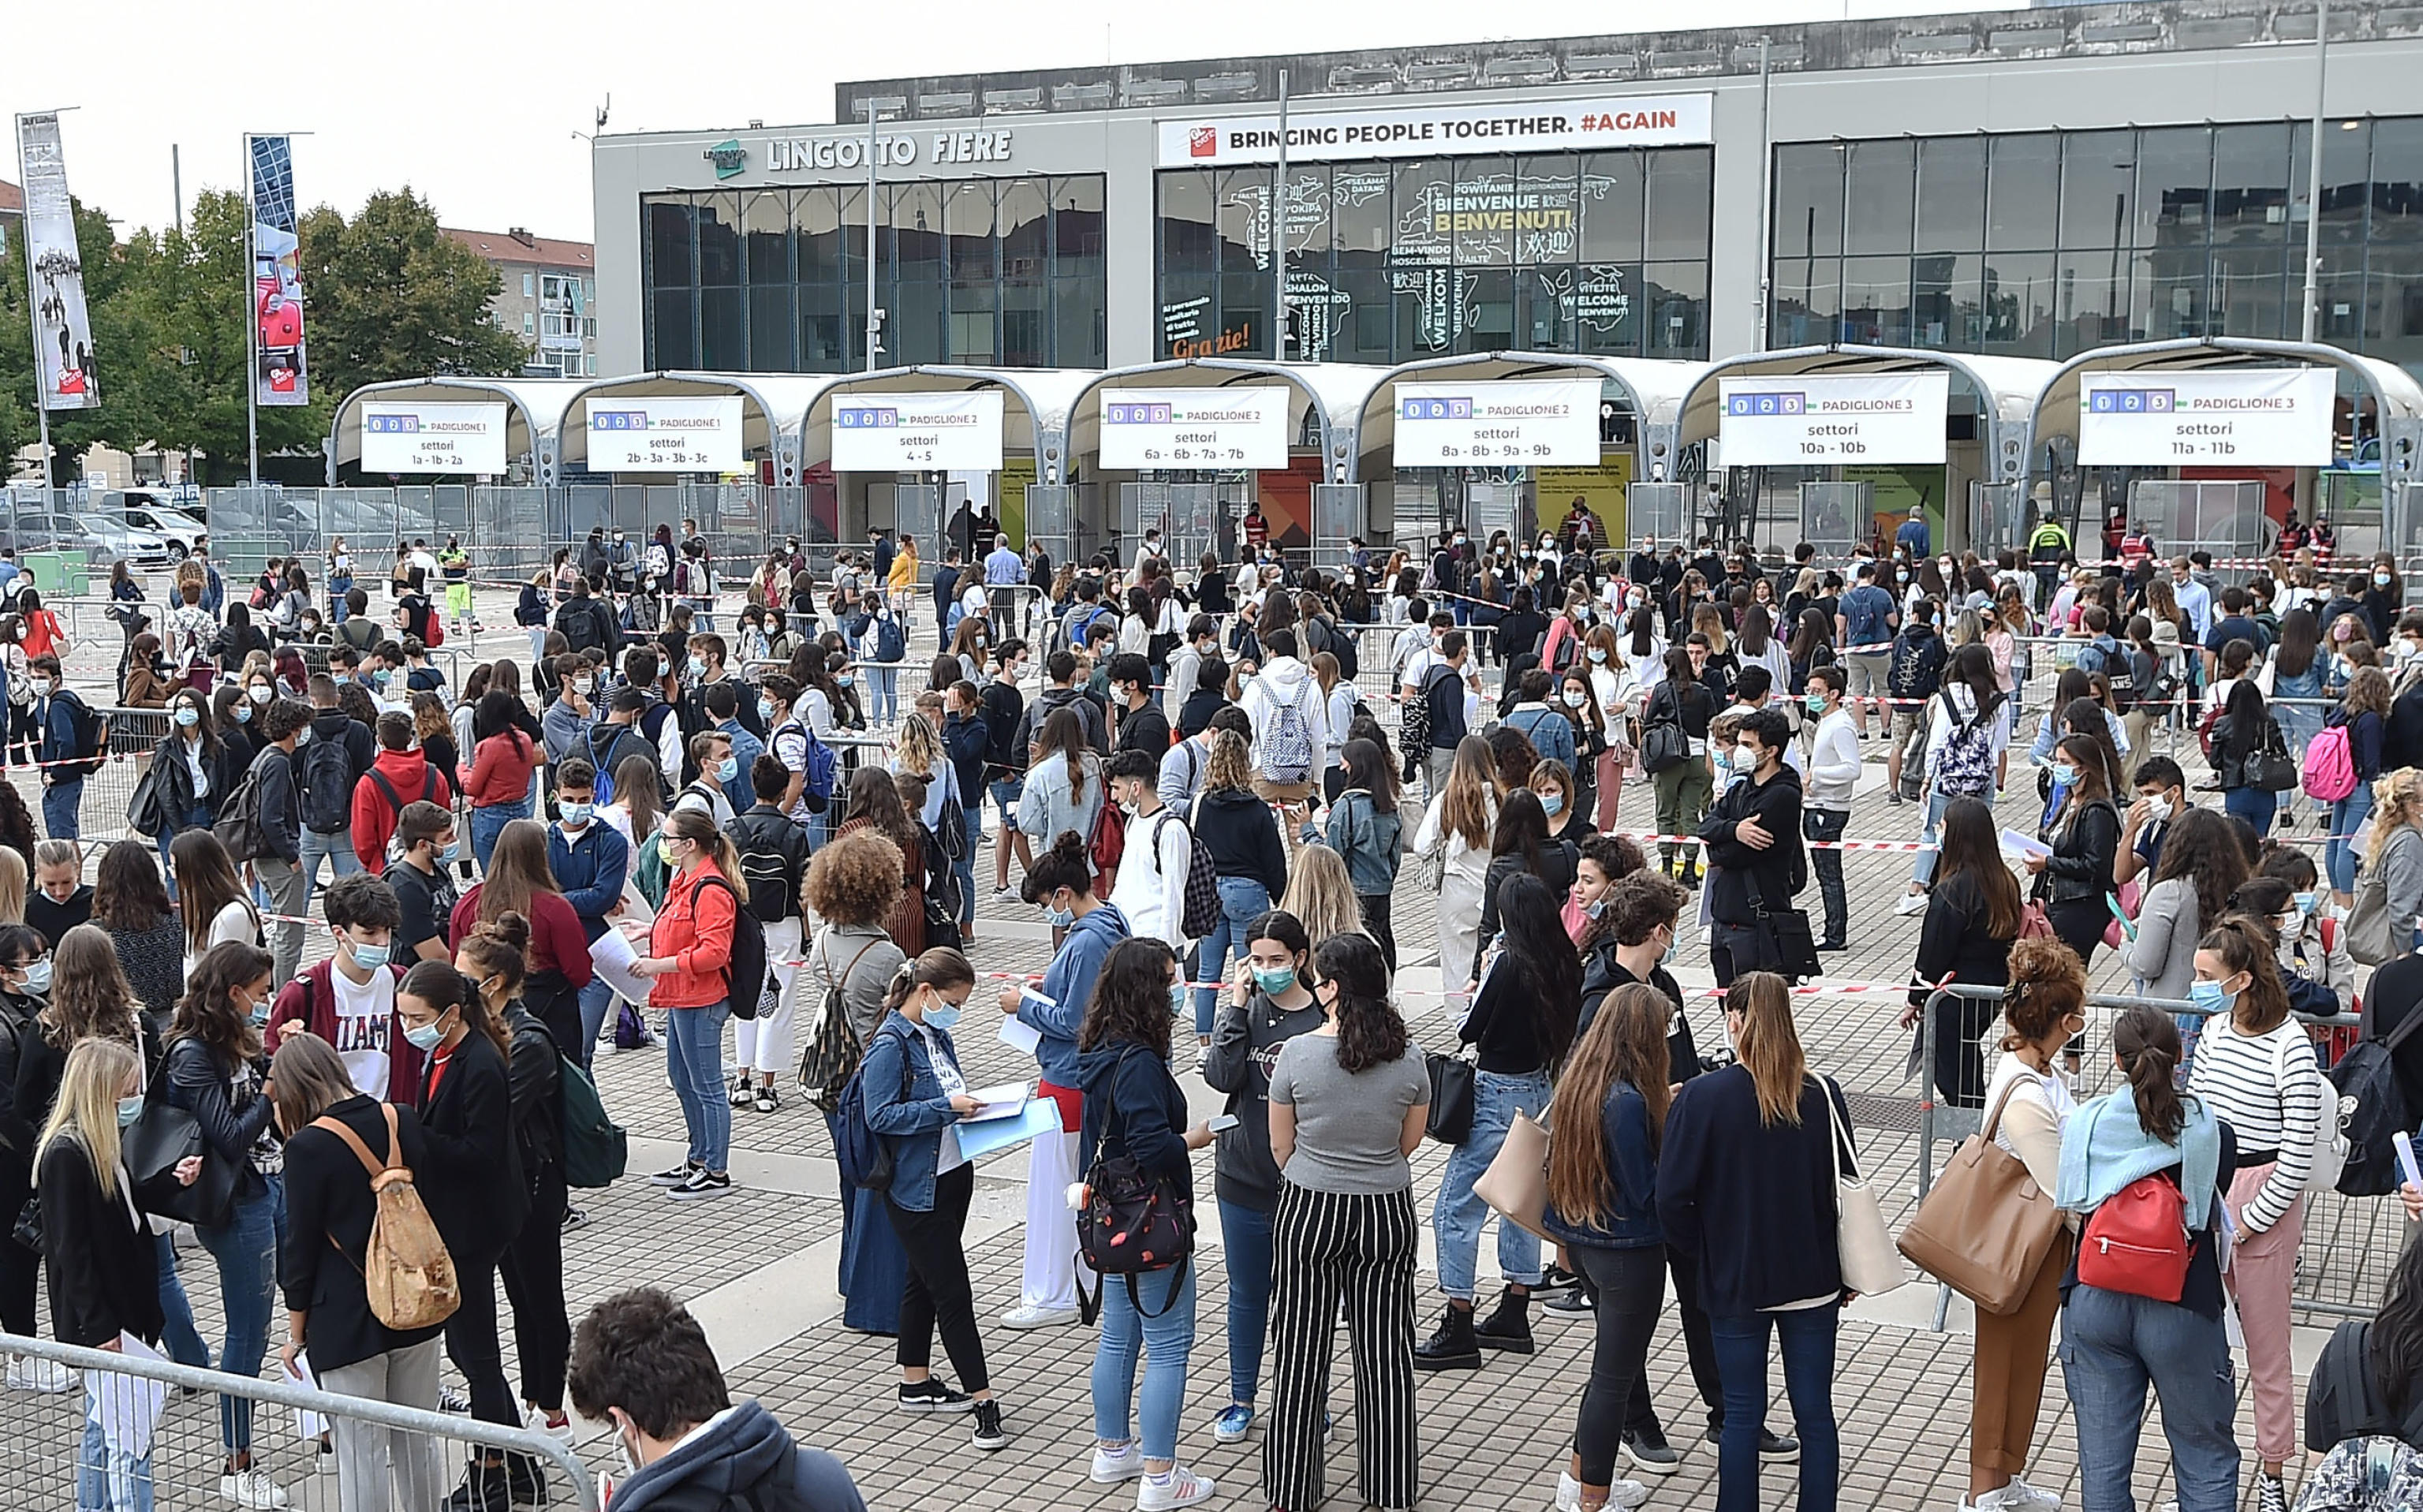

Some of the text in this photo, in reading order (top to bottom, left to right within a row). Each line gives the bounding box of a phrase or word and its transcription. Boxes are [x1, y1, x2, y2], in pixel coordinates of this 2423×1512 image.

[1230, 110, 1676, 148] BRINGING PEOPLE TOGETHER. #AGAIN
[931, 130, 1012, 163] FIERE
[1454, 184, 1514, 194] POWITANIE
[1436, 195, 1539, 211] BIENVENUE
[1436, 211, 1571, 232] BENVENUTI
[1258, 185, 1269, 271] WELCOME
[1285, 284, 1329, 293] SHALOM
[1454, 268, 1463, 332] BIENVENUE
[1562, 295, 1628, 306] WELCOME
[1434, 269, 1447, 345] WELKOM
[1173, 323, 1249, 358] Grazie!
[1823, 401, 1902, 410] PADIGLIONE
[2193, 398, 2283, 409] PADIGLIONE
[1488, 405, 1559, 415] PADIGLIONE
[909, 415, 969, 424] PADIGLIONE
[1187, 412, 1252, 420] PADIGLIONE
[431, 423, 481, 431] PADIGLIONE
[660, 419, 715, 427] PADIGLIONE
[2177, 421, 2232, 435] settori
[1473, 427, 1519, 439] settori
[1808, 423, 1858, 435] settori
[900, 434, 938, 446] settori
[1175, 431, 1216, 442] settori
[421, 440, 454, 450] settori
[649, 437, 685, 448] settori
[1800, 442, 1824, 454] 10a
[1840, 442, 1865, 454] 10b
[2171, 442, 2194, 454] 11a
[2212, 442, 2235, 454] 11b
[907, 451, 914, 461] 4
[925, 451, 931, 461] 5
[1144, 449, 1160, 459] 6a
[1174, 449, 1190, 459] 6b
[1201, 449, 1216, 459] 7a
[1228, 449, 1244, 459] 7b
[1442, 445, 1458, 456] 8a
[1472, 445, 1489, 456] 8b
[1503, 445, 1519, 456] 9a
[1533, 445, 1551, 456] 9b
[413, 455, 422, 465] 1a
[432, 455, 442, 465] 1b
[451, 455, 462, 465] 2a
[627, 453, 640, 463] 2b
[650, 454, 663, 463] 3a
[673, 453, 685, 463] 3b
[695, 454, 707, 463] 3c
